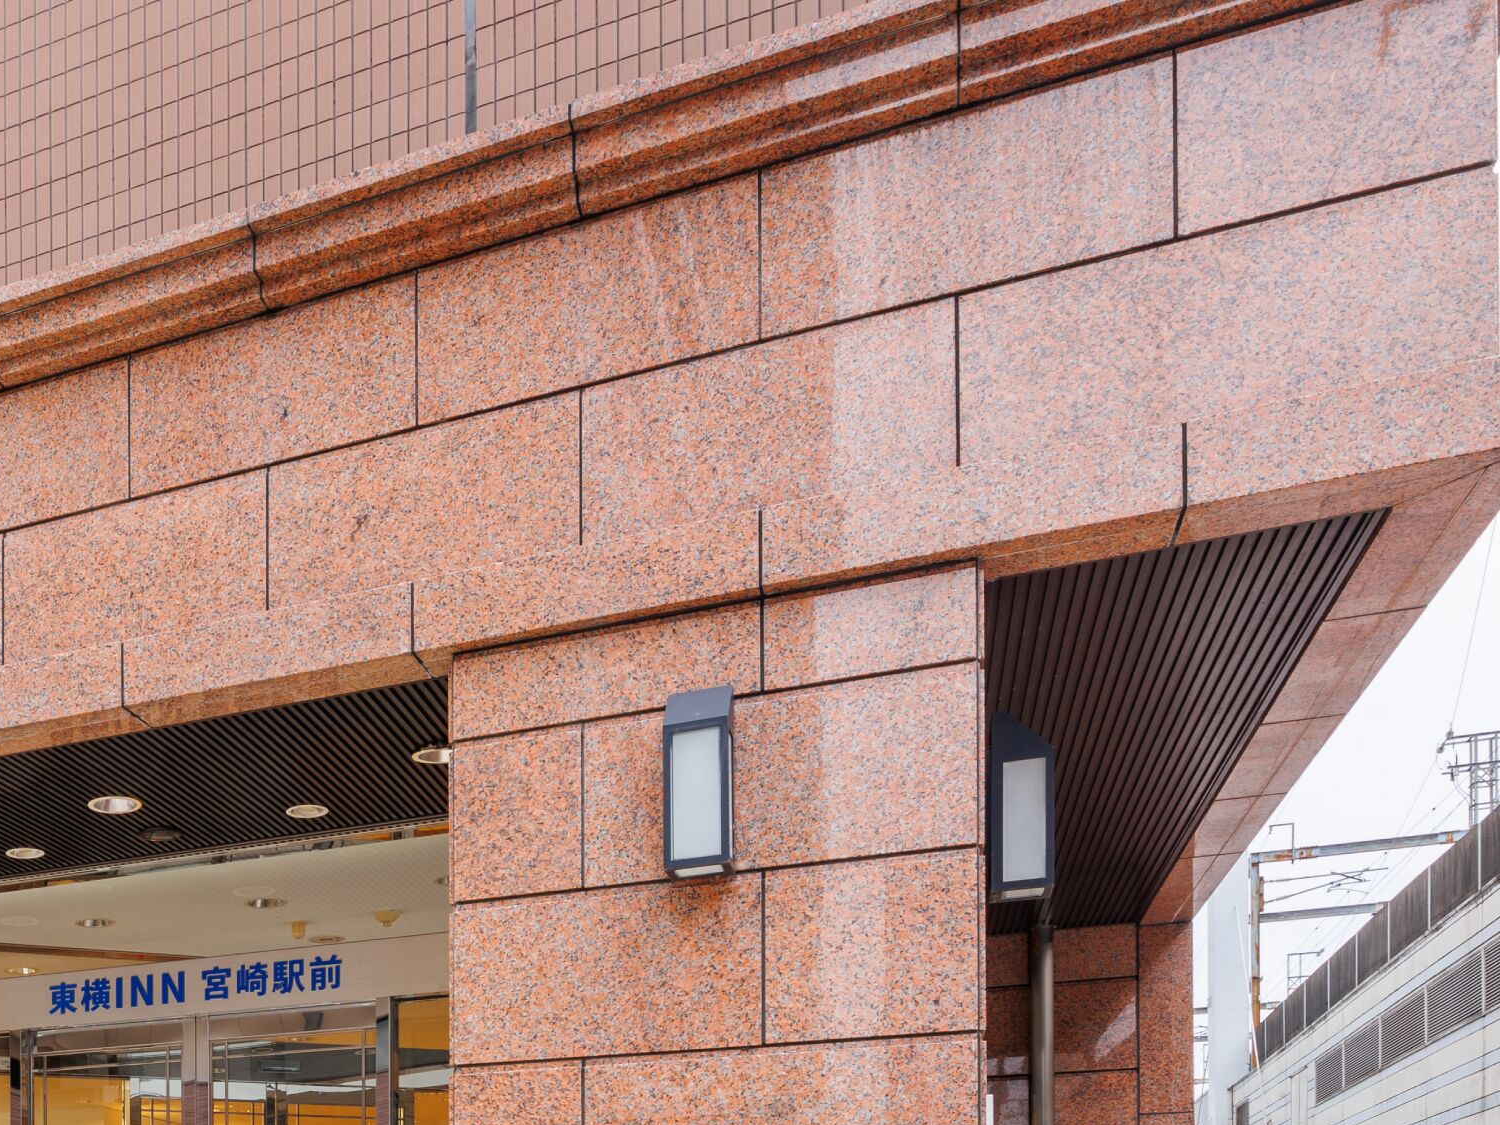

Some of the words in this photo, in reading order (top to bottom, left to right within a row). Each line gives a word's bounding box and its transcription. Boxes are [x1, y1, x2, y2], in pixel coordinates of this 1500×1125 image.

[49, 970, 186, 1015] 東横INN
[201, 954, 343, 1001] 宮崎駅前
